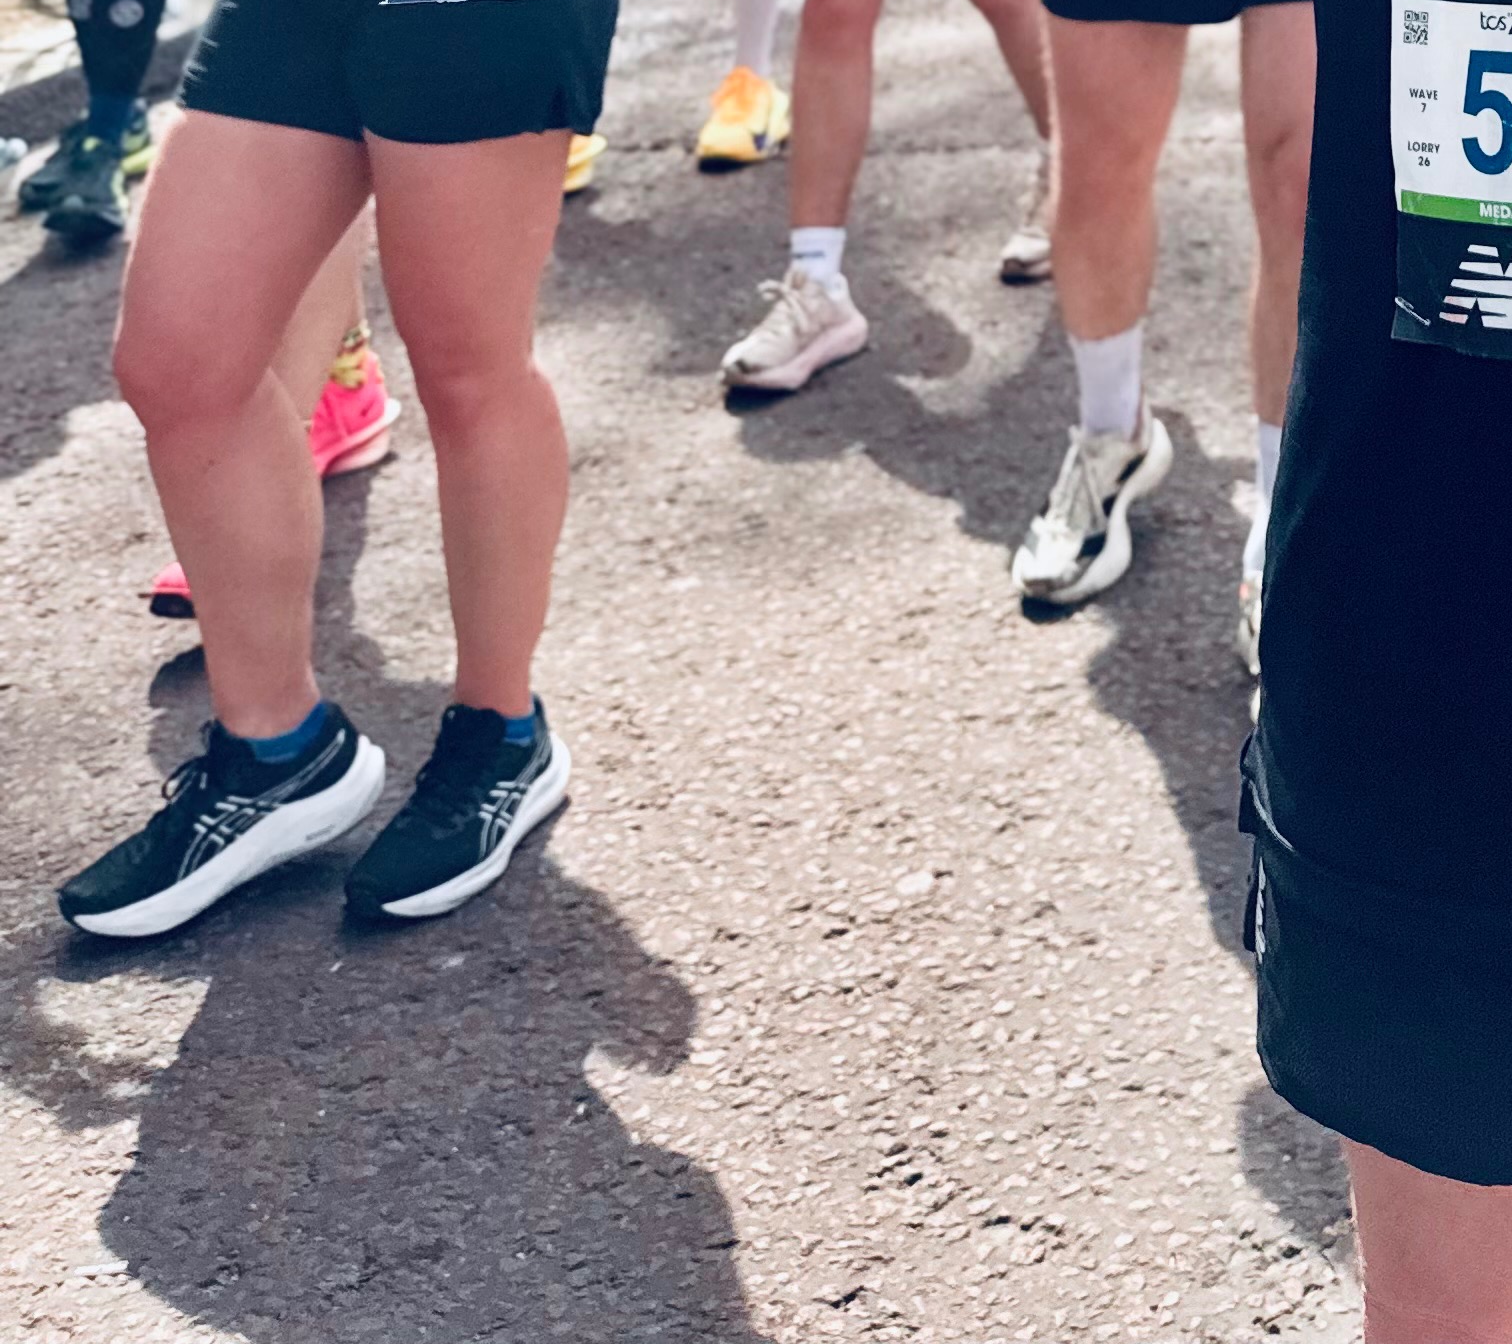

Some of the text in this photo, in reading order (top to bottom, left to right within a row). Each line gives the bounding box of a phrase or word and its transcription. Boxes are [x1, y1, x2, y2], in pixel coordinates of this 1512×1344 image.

[1409, 87, 1439, 101] WAVE
[1420, 101, 1427, 113] 7
[1407, 140, 1441, 154] LORRY
[1417, 155, 1431, 167] 26
